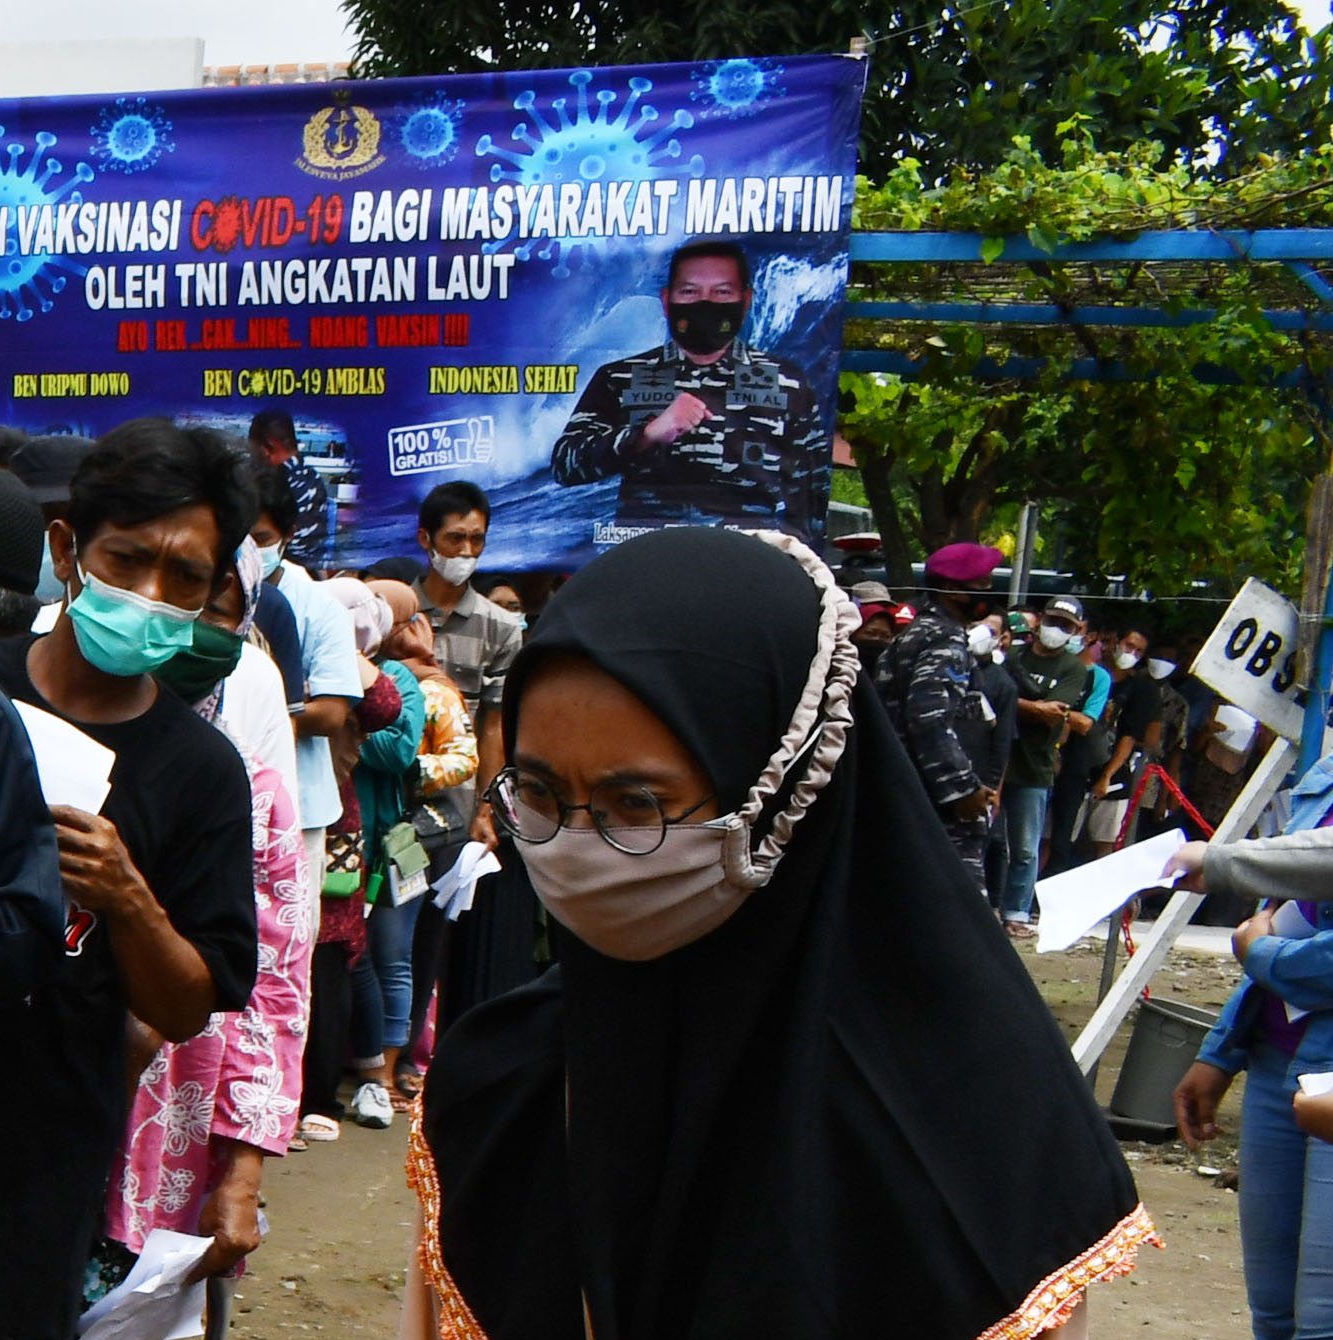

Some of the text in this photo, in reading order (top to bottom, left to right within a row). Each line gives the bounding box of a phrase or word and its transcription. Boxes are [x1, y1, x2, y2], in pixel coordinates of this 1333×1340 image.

[17, 199, 182, 257] VAKSINASI
[190, 193, 345, 252] COVID-19
[349, 188, 433, 243] BAGI
[440, 179, 678, 241] MASYARAKAT
[685, 175, 843, 234] MARITIM
[85, 253, 516, 310] OLEH TNI ANGKATAN LAUT
[118, 320, 149, 352] AYO
[375, 314, 440, 347] VAKSIN
[13, 372, 130, 397] BEN URIPMU DOWO
[204, 367, 385, 397] BEN COVID-19 AMBLAS
[429, 365, 579, 394] INDONESIA SEHAT
[631, 393, 675, 402] YUDO
[733, 393, 782, 406] TNI AL
[394, 427, 452, 454] 100 %
[395, 449, 453, 469] GRATIS!
